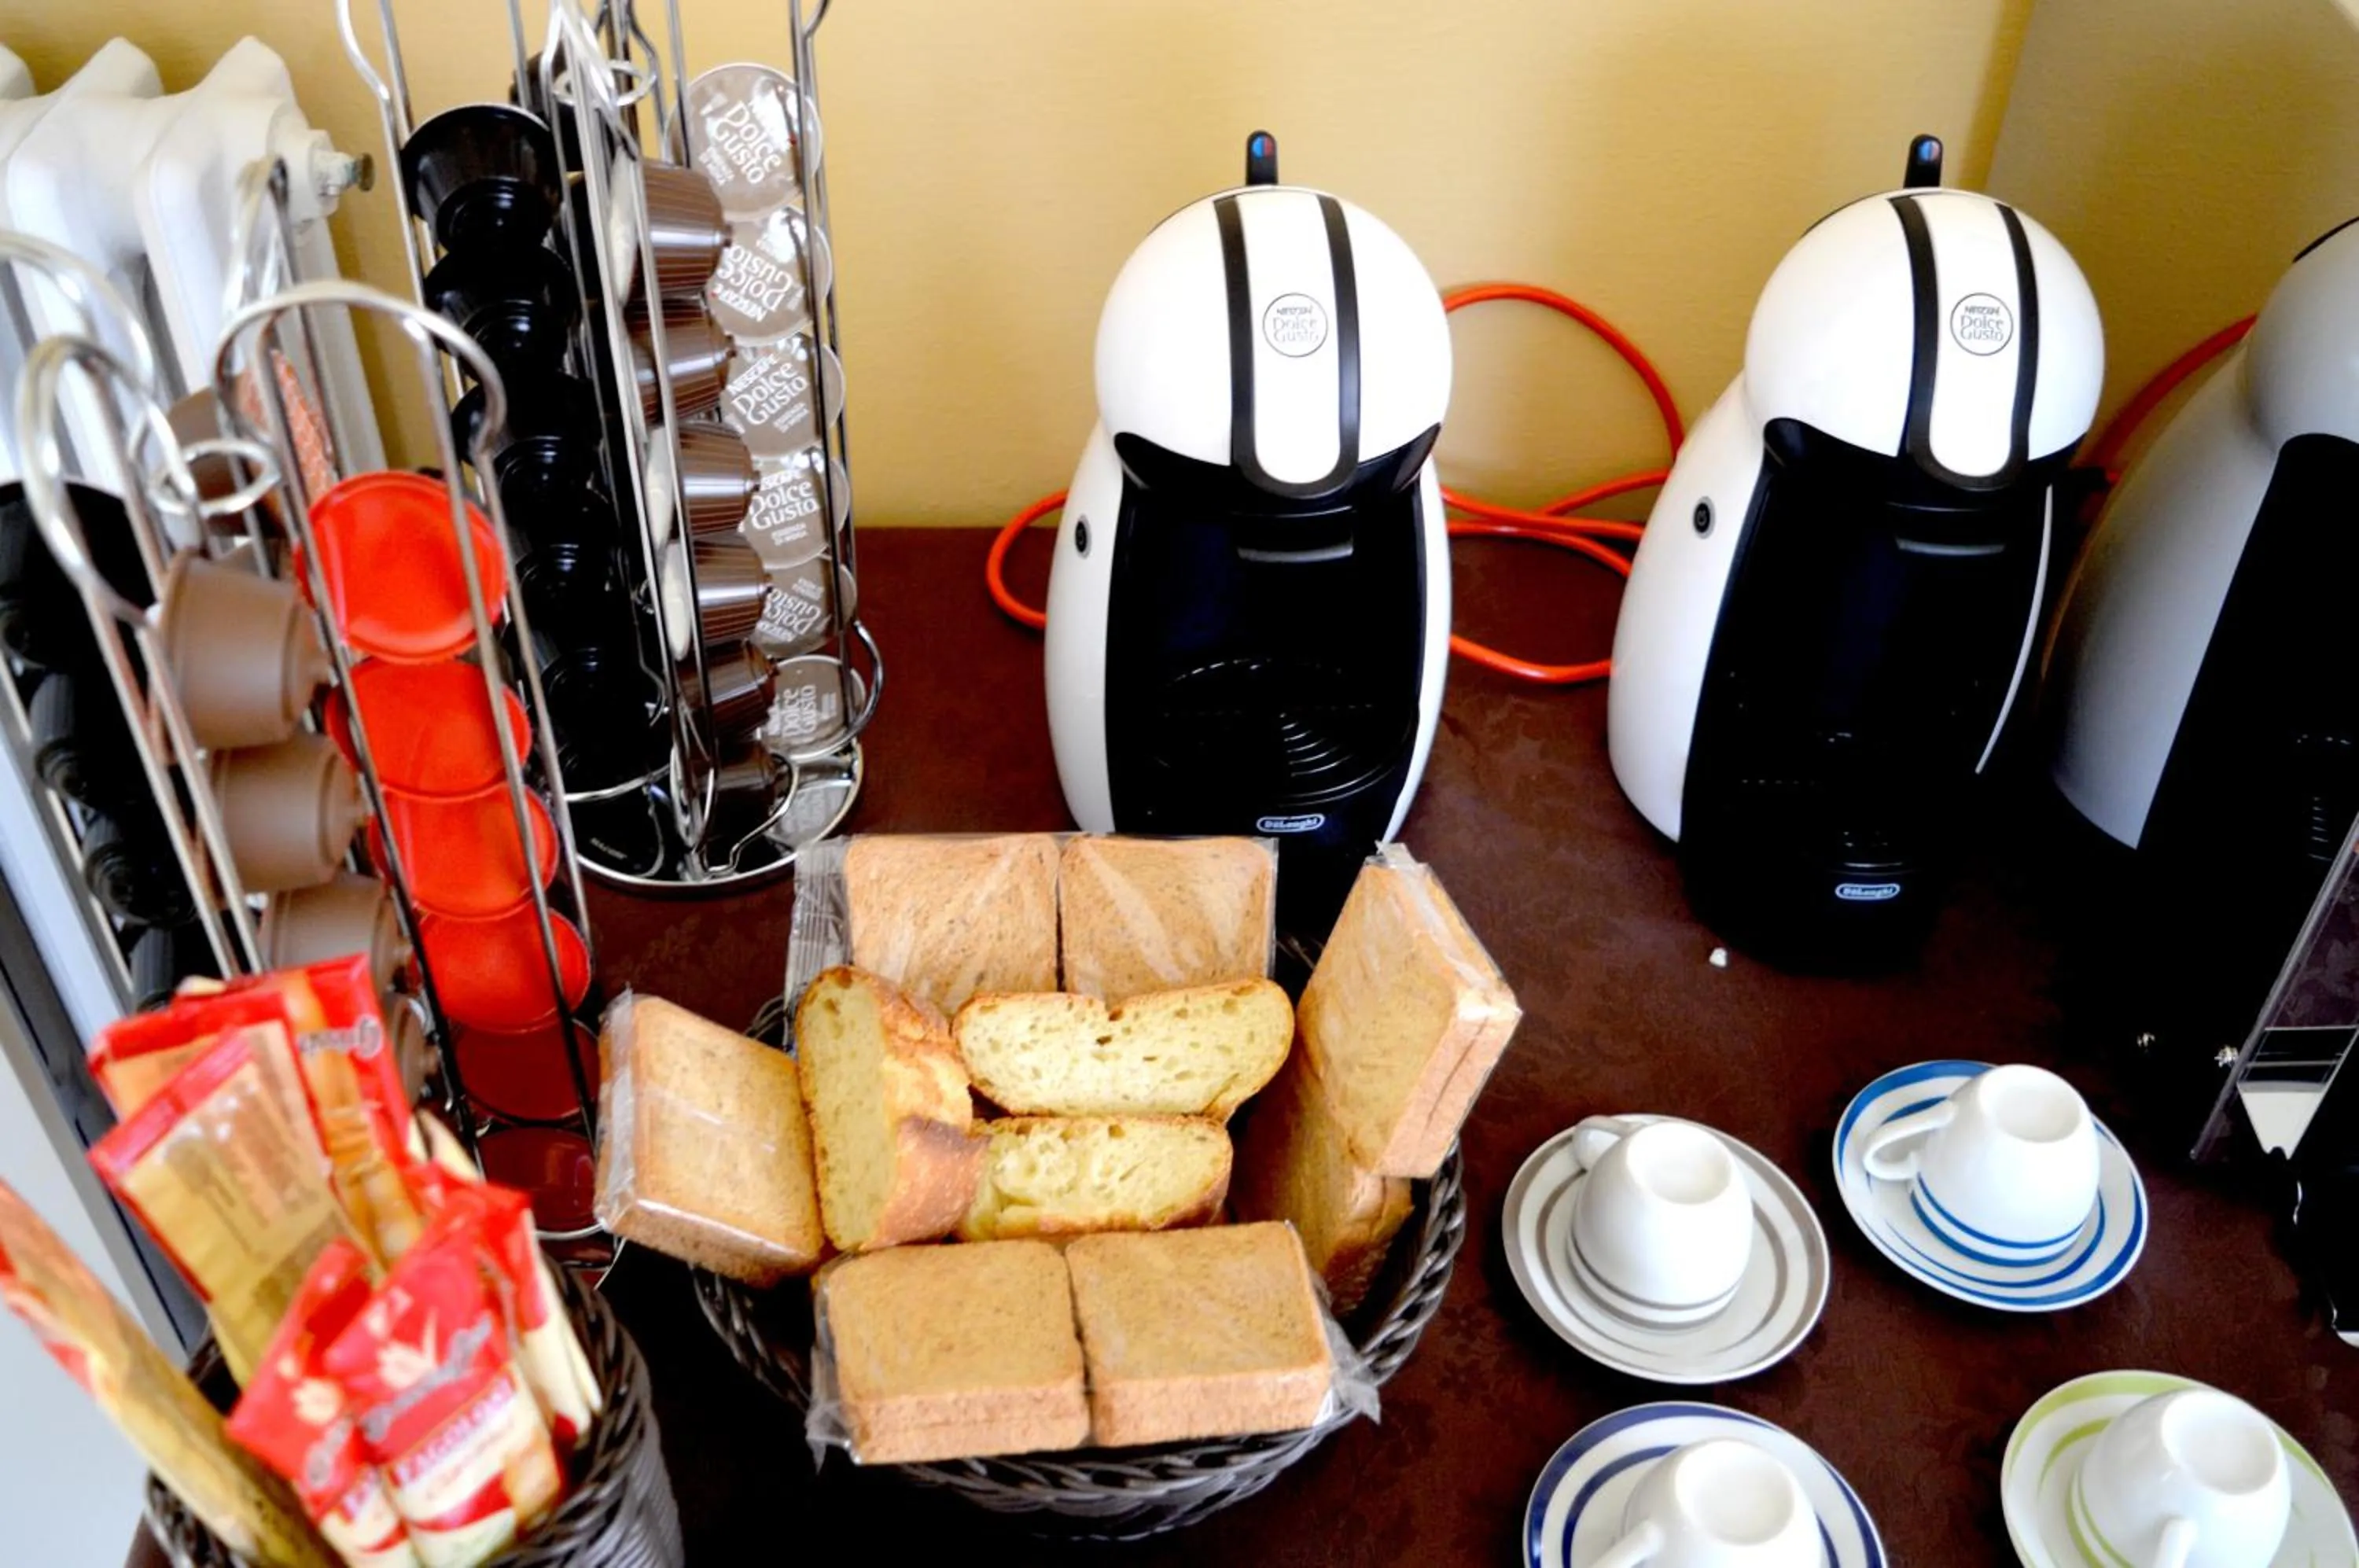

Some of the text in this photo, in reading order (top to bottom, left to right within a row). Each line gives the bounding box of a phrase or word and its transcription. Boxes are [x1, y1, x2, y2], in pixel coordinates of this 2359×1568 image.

[712, 117, 764, 184] Gusto
[723, 100, 782, 172] Dolce
[717, 260, 785, 312] Dolce
[730, 244, 793, 294] Gusto
[1960, 315, 2004, 329] Dolce
[1960, 326, 2004, 341] Gusto
[732, 363, 798, 414] Dolce
[746, 376, 809, 425] Gusto
[749, 480, 812, 514] Dolce
[751, 498, 819, 530] Gusto
[771, 588, 822, 619] Gusto
[783, 688, 800, 737] Dolce
[801, 684, 816, 734] Gusto
